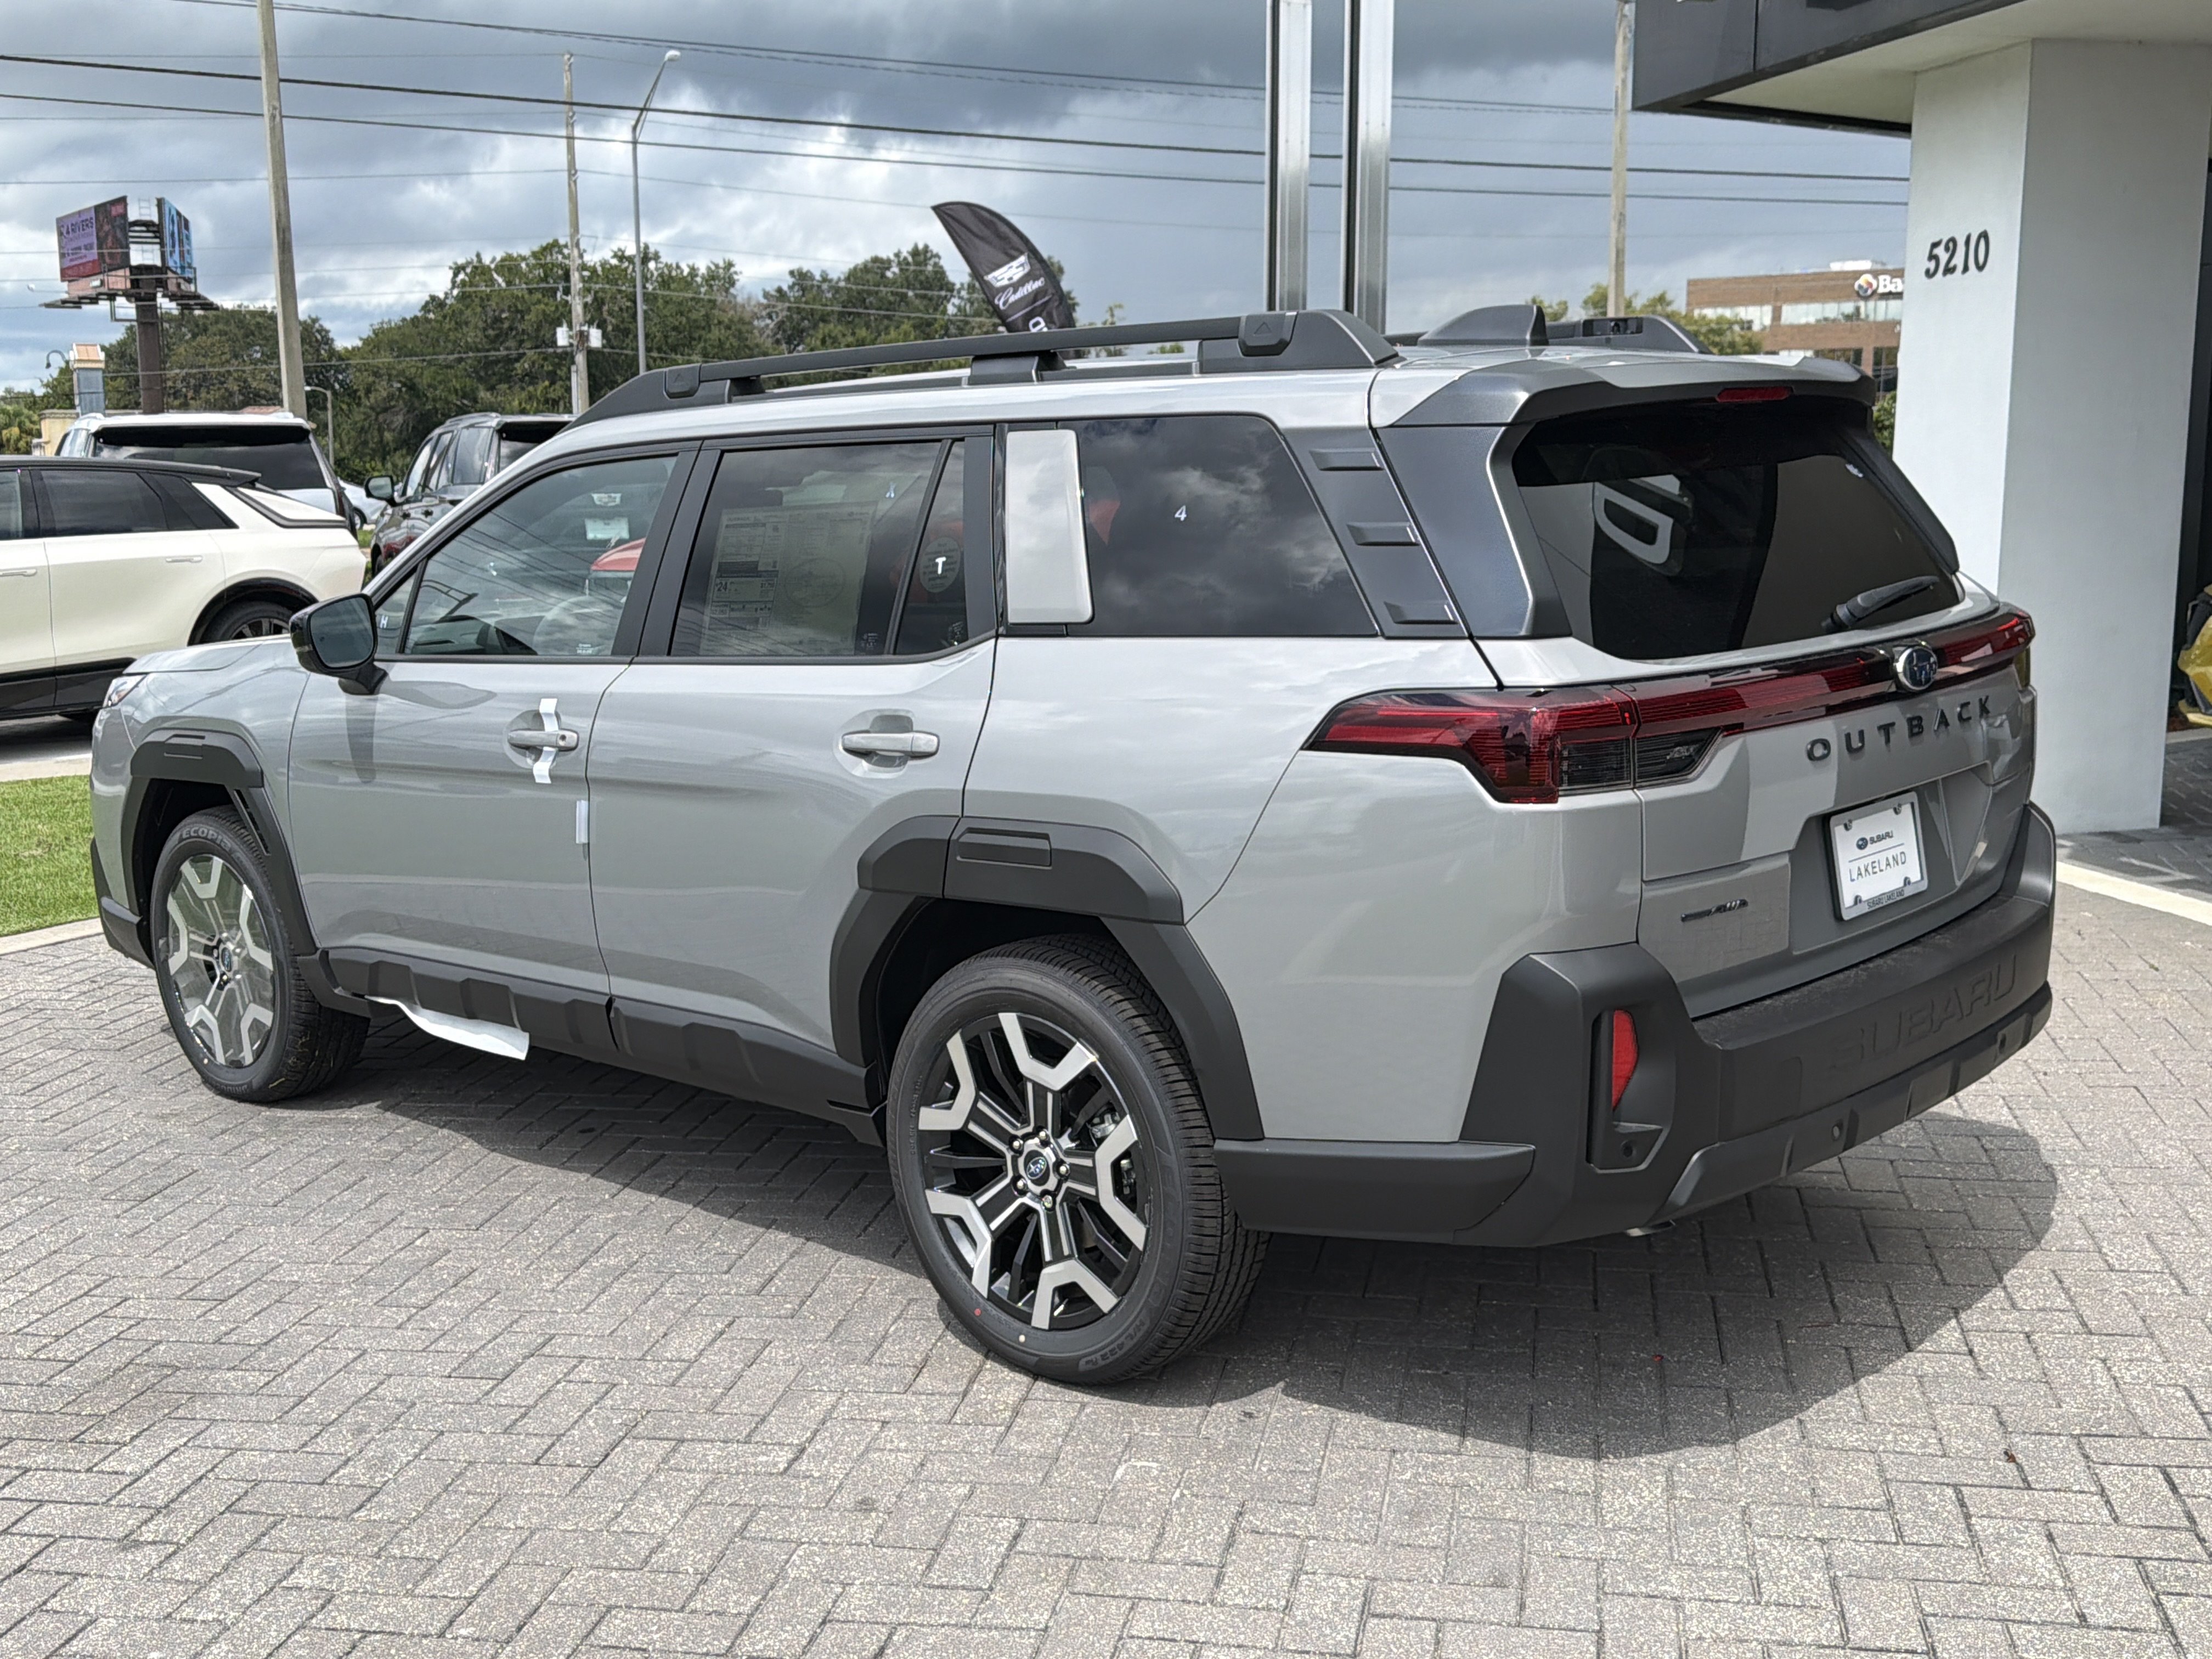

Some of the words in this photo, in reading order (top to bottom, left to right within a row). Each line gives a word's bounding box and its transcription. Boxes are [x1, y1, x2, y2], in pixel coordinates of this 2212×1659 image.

[71, 217, 94, 234] RIVERS
[1925, 229, 1990, 279] 5210
[995, 277, 1045, 310] Cadillac
[1877, 275, 1904, 293] Ba
[1807, 696, 1990, 761] OUTBACK
[182, 827, 231, 851] ECOPIA
[1869, 830, 1894, 845] SUBARU
[1849, 851, 1906, 882] LAKELAND
[1867, 898, 1884, 910] SUBARU
[1884, 889, 1905, 904] LAKELAND
[1829, 953, 2018, 1070] SUBARU
